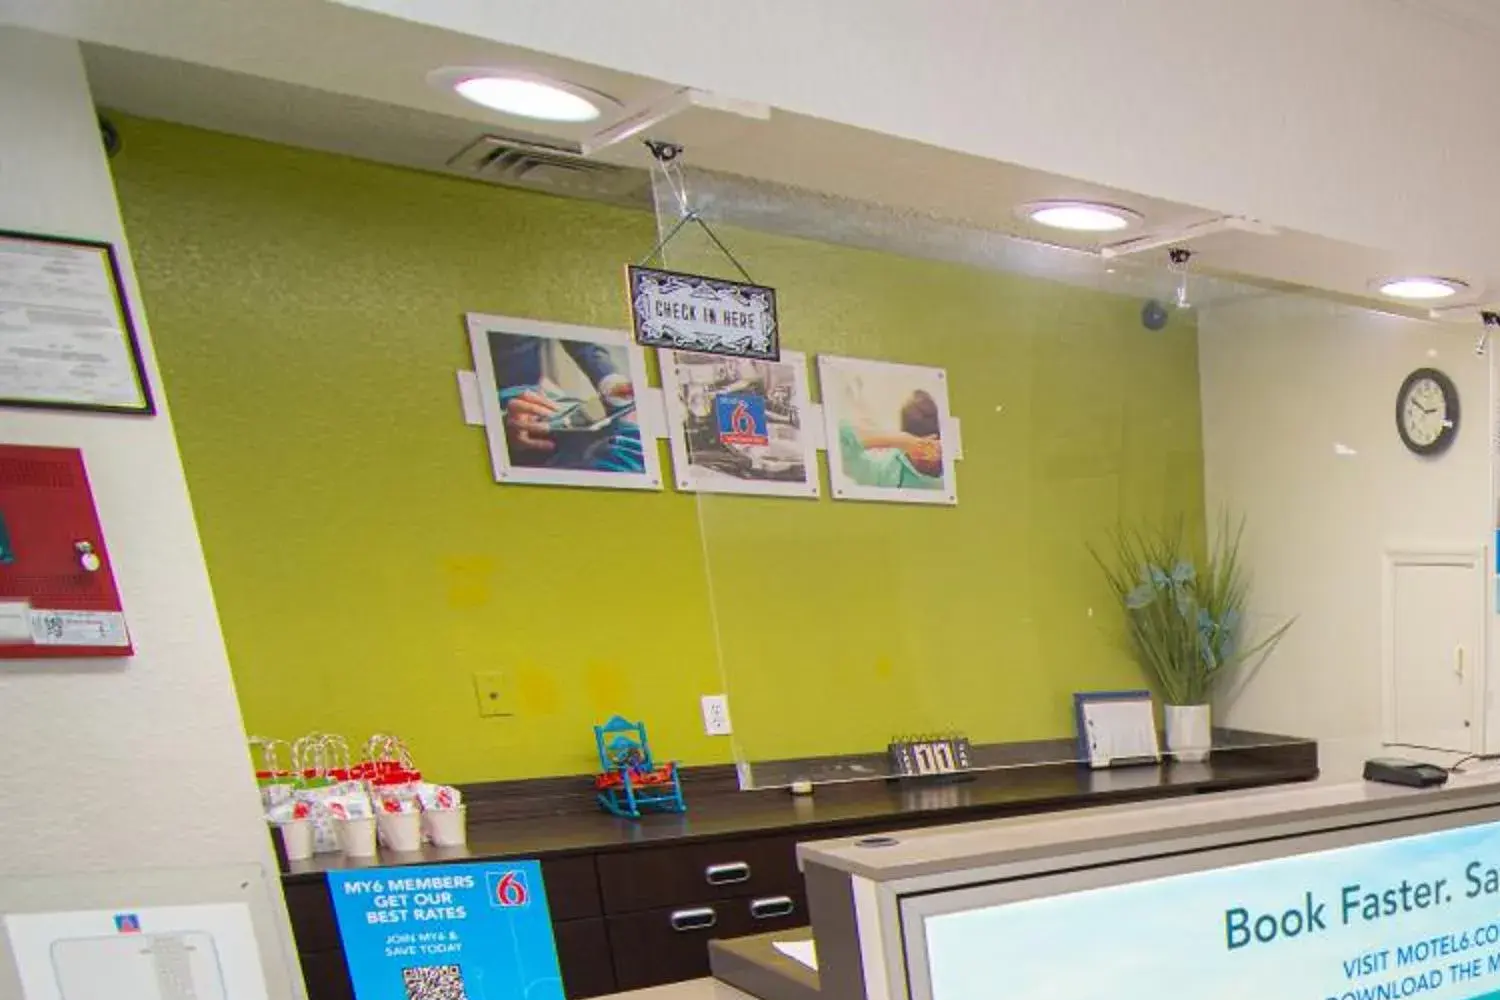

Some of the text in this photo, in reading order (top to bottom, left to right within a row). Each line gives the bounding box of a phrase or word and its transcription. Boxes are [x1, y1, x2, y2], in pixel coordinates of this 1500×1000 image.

[655, 300, 756, 330] CHECK IN HERE
[344, 875, 475, 895] MY6 MEMBERS
[498, 871, 527, 906] 6
[374, 892, 454, 909] GET OUR
[366, 906, 467, 924] BEST RATES
[1224, 891, 1327, 950] Book
[1341, 878, 1453, 925] Faster.
[385, 934, 417, 945] JOIN
[418, 932, 441, 943] MY6
[385, 943, 463, 957] SAVE TODAY
[1343, 949, 1391, 979] VISIT
[1449, 958, 1482, 983] THE
